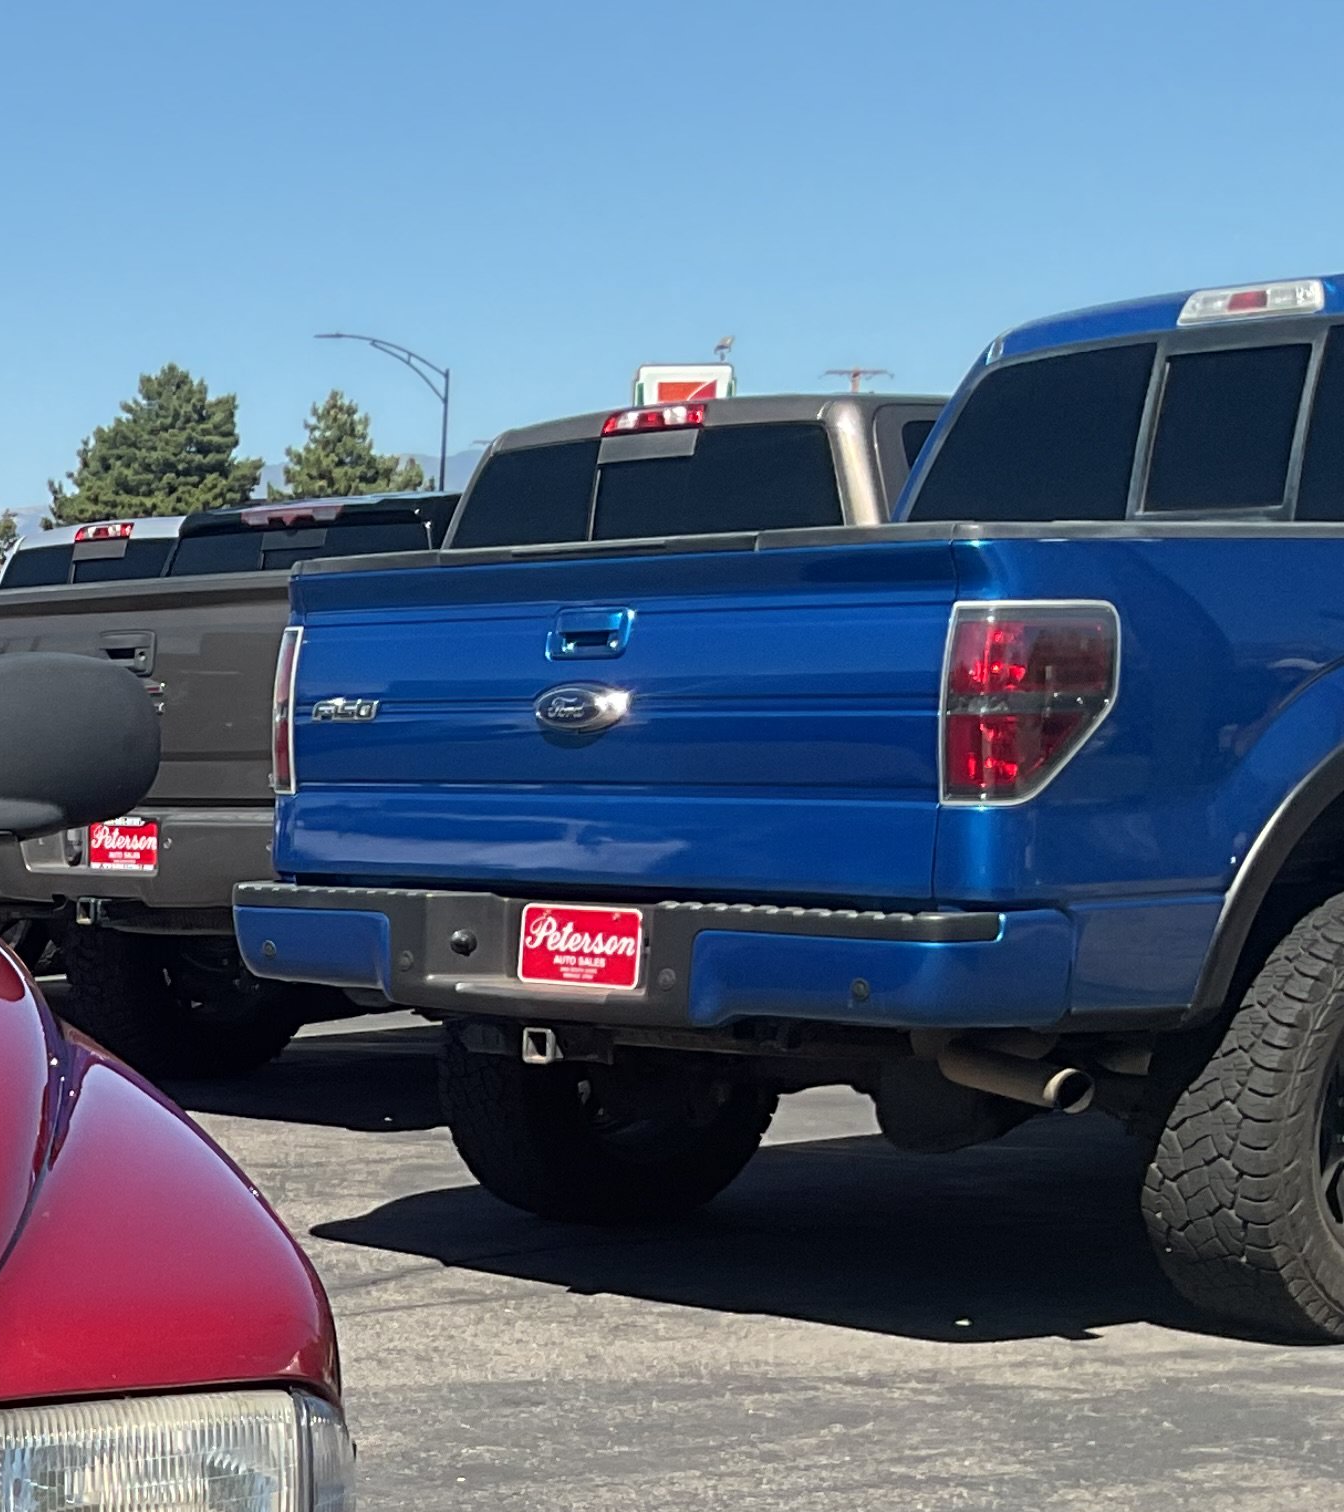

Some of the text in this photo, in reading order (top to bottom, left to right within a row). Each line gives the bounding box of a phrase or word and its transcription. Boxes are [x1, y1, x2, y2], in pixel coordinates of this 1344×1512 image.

[548, 696, 586, 718] Ford
[92, 825, 157, 850] Peterson
[525, 916, 635, 956] Peterson
[553, 955, 607, 968] AUTO SALES
